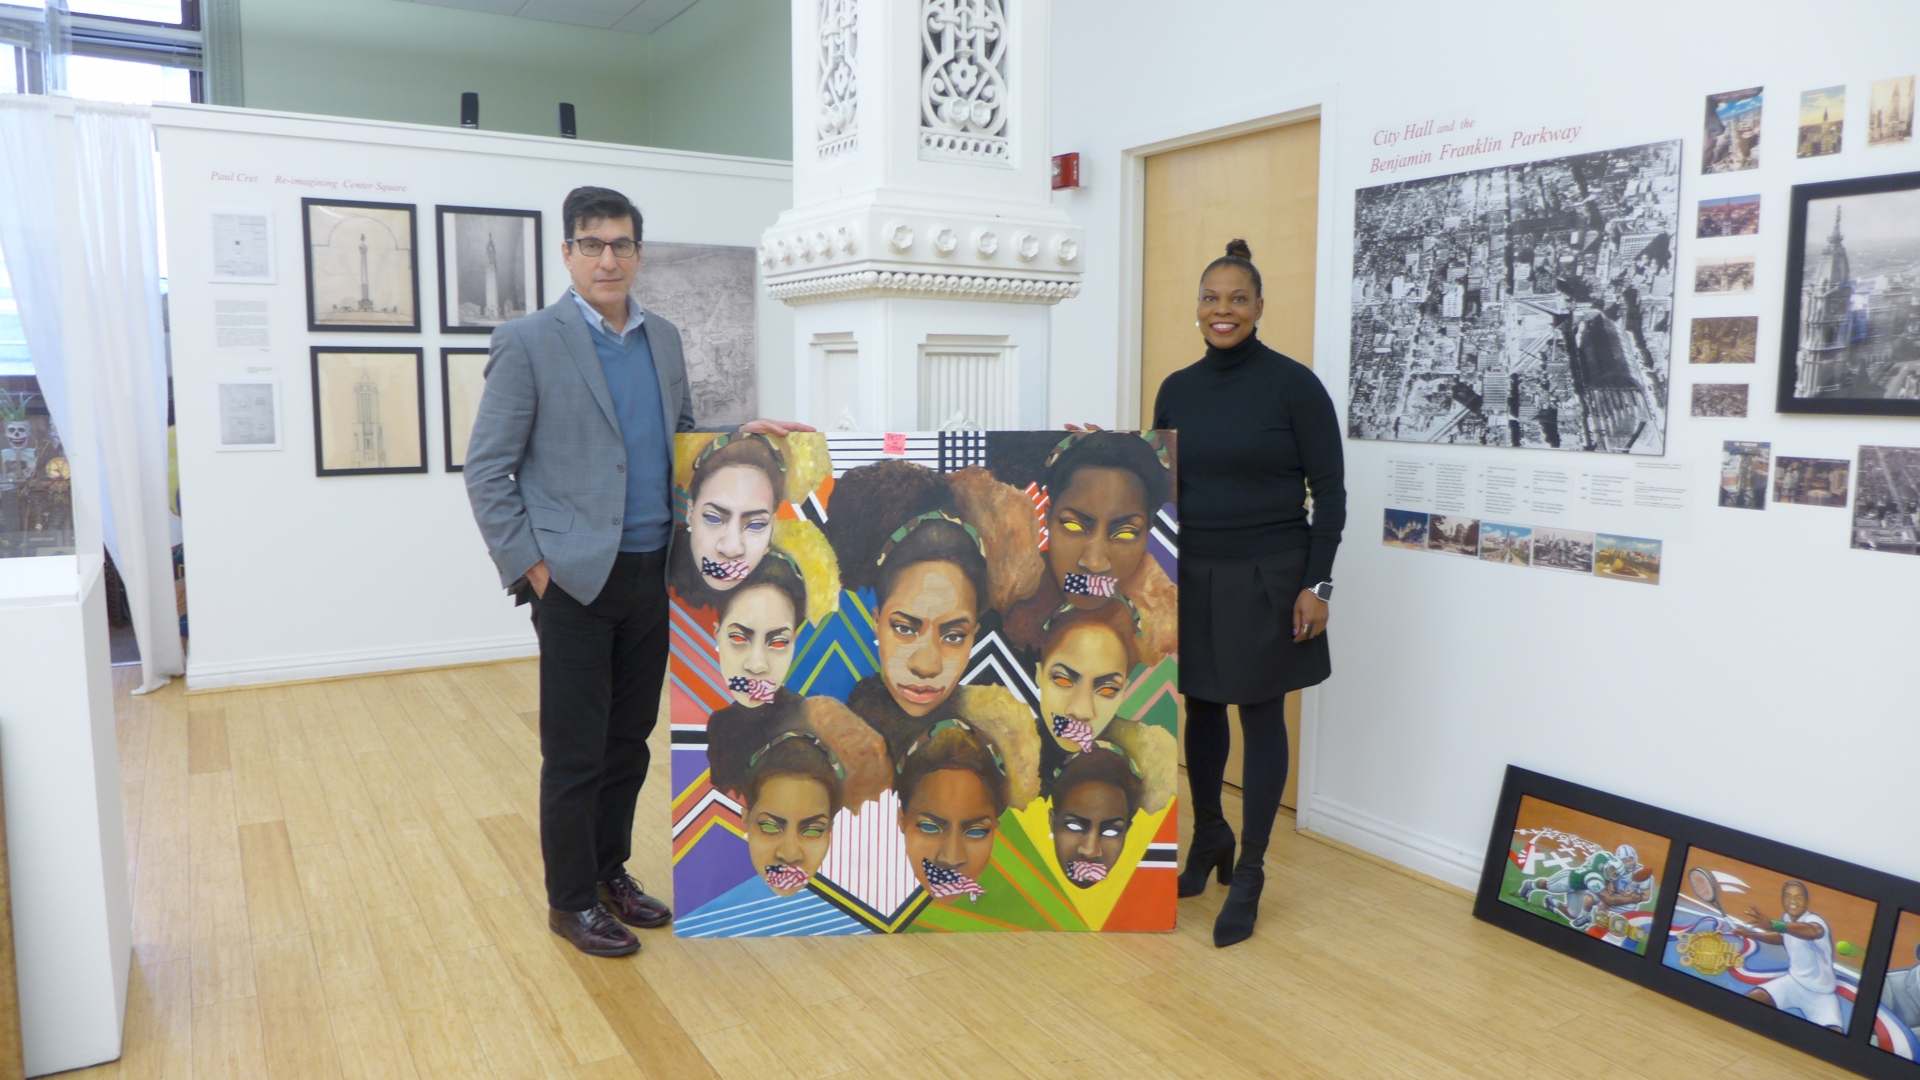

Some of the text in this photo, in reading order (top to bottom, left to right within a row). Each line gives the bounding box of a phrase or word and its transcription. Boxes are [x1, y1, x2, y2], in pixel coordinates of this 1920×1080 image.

[1373, 117, 1475, 147] City Hall and the
[1370, 125, 1582, 173] Benjamin Franklin Parkway
[210, 171, 407, 193] Paul Cret Re-imagining Center Square
[1676, 932, 1739, 954] Johnny
[1679, 950, 1744, 971] Sample
